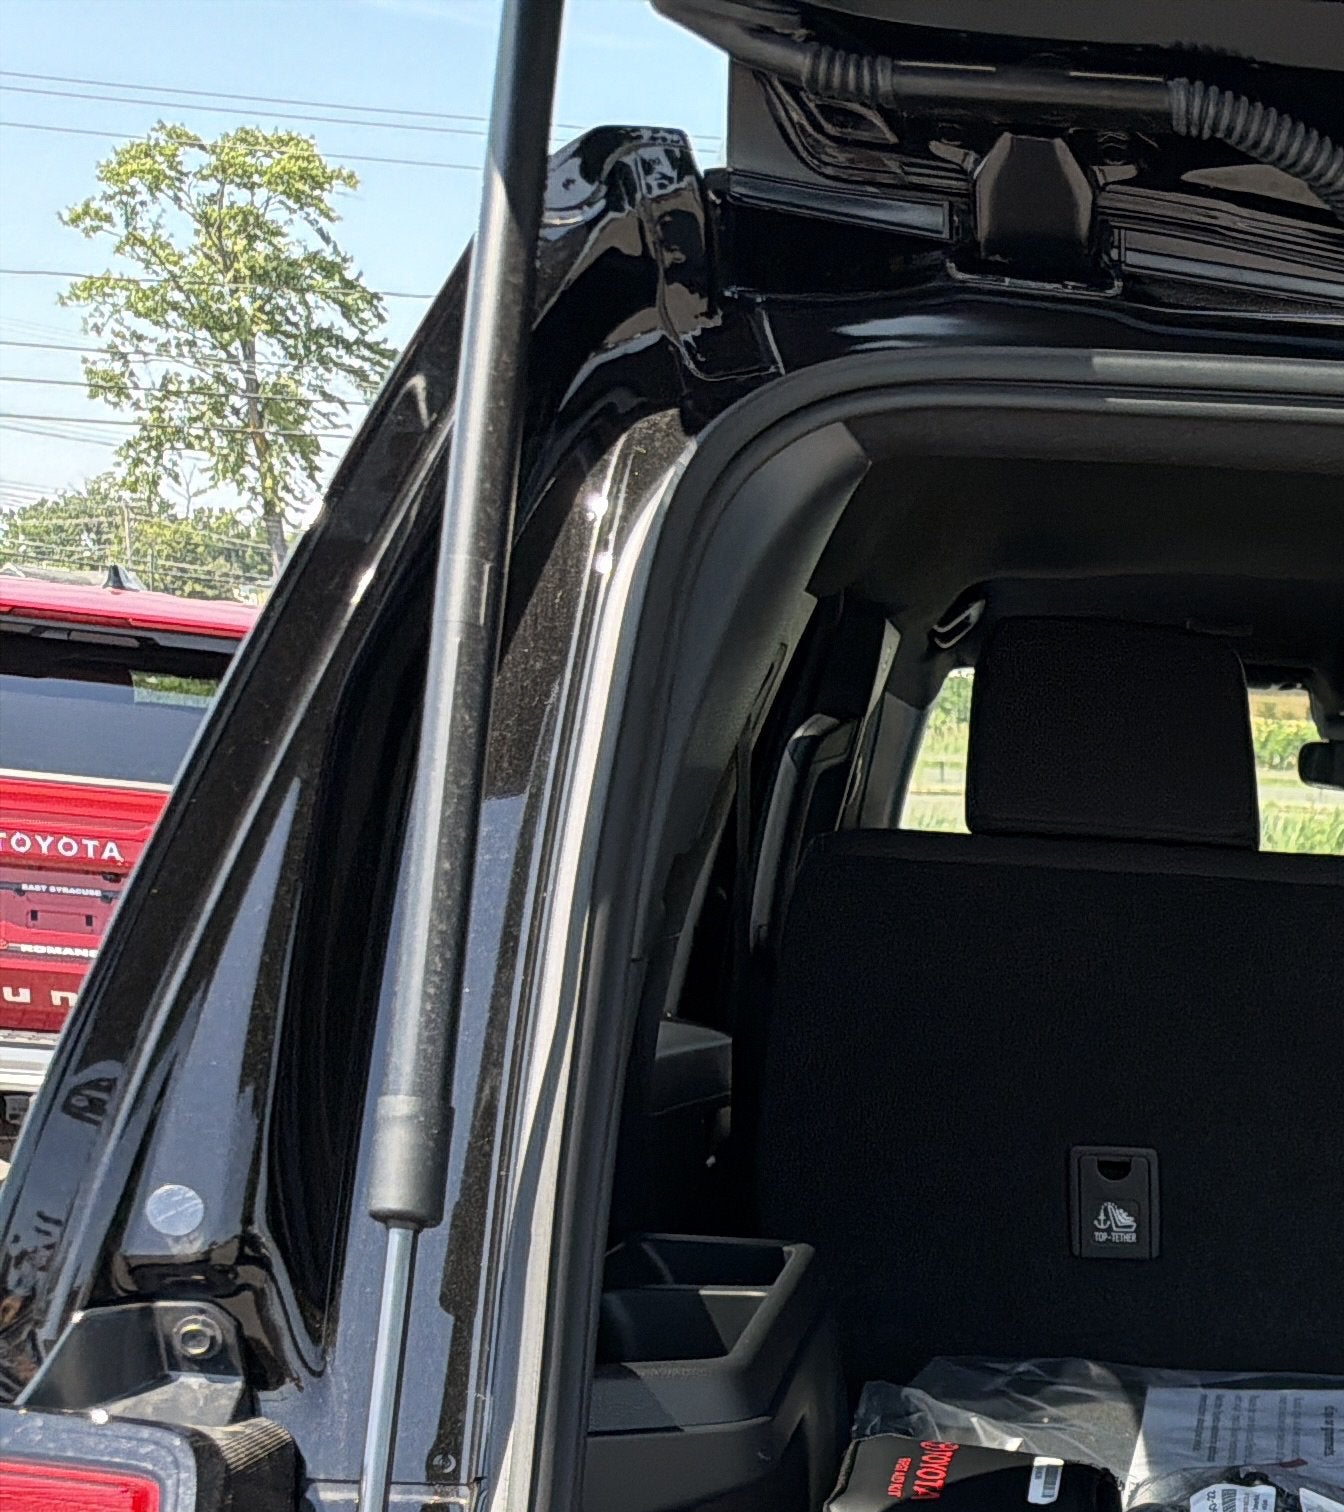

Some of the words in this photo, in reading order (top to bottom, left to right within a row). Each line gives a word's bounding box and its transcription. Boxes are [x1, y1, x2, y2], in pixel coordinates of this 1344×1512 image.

[1093, 1232, 1137, 1242] TOP-TETHER
[911, 1450, 954, 1500] TOYOTA
[887, 1483, 903, 1498] KIT
